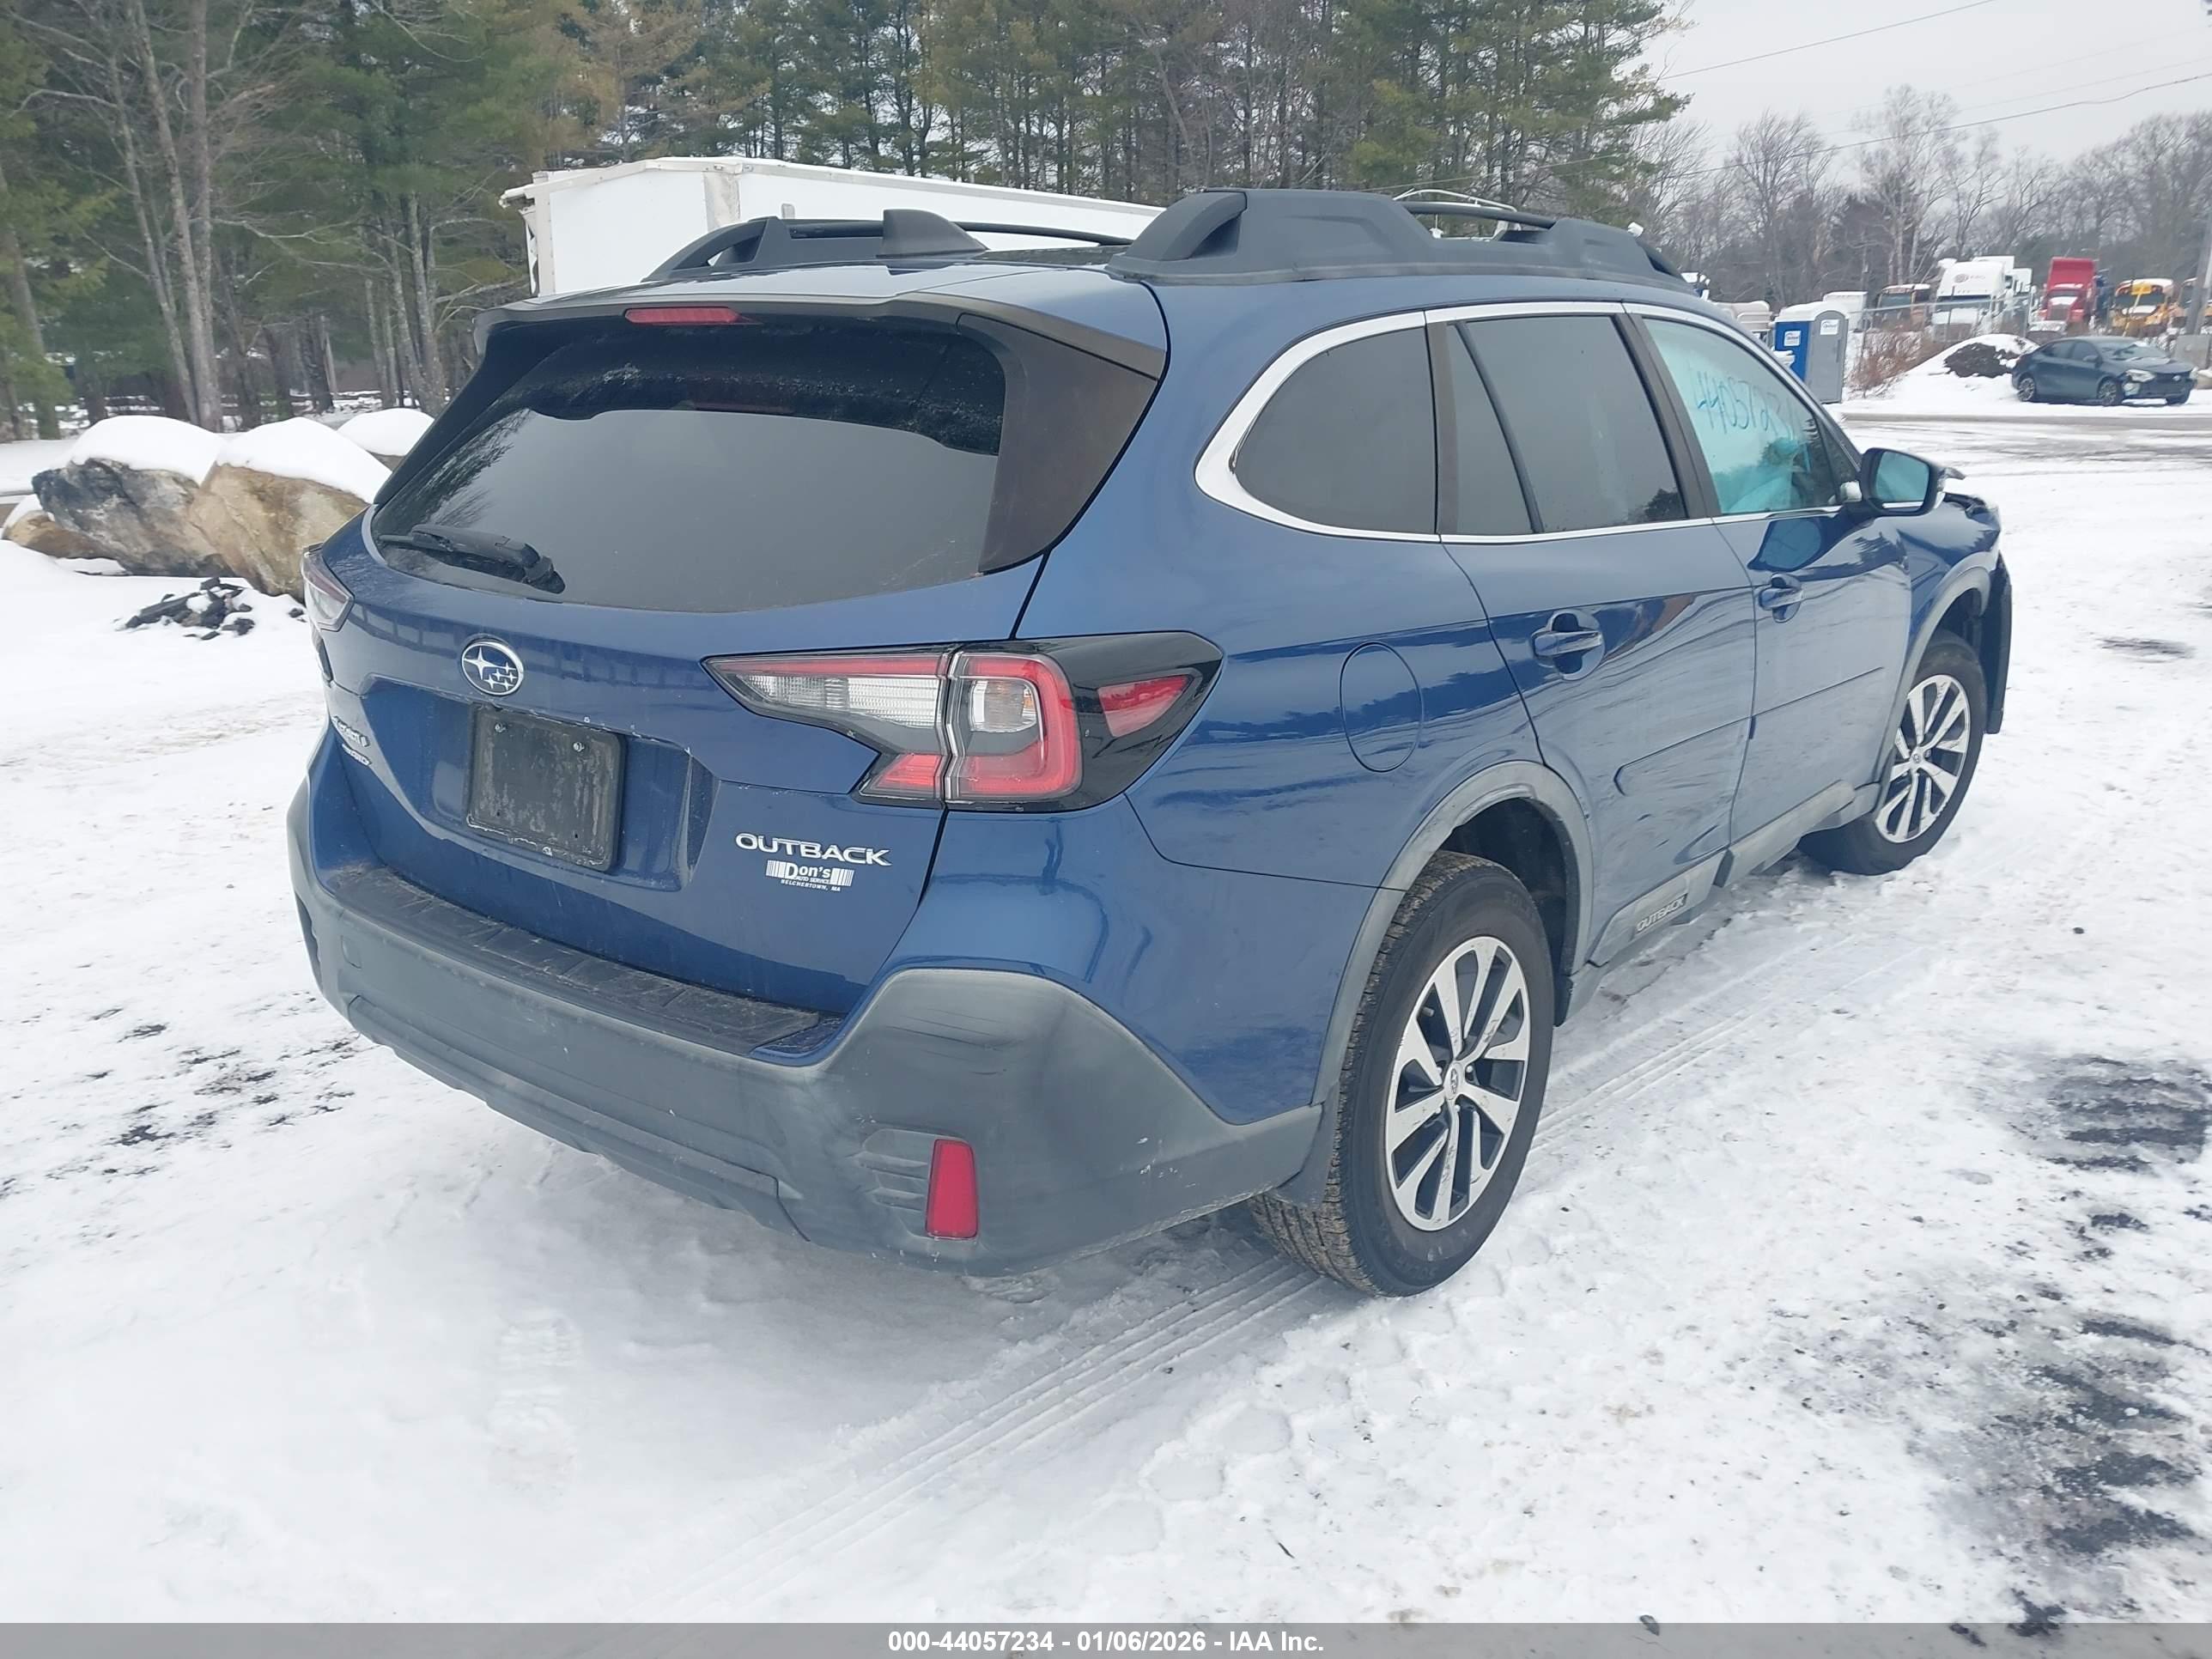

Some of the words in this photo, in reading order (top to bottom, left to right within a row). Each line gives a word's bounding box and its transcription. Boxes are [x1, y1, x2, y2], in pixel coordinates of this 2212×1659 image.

[735, 833, 892, 866] OUTBACK
[785, 862, 831, 879] Don's
[1637, 895, 1685, 932] OUTBACK
